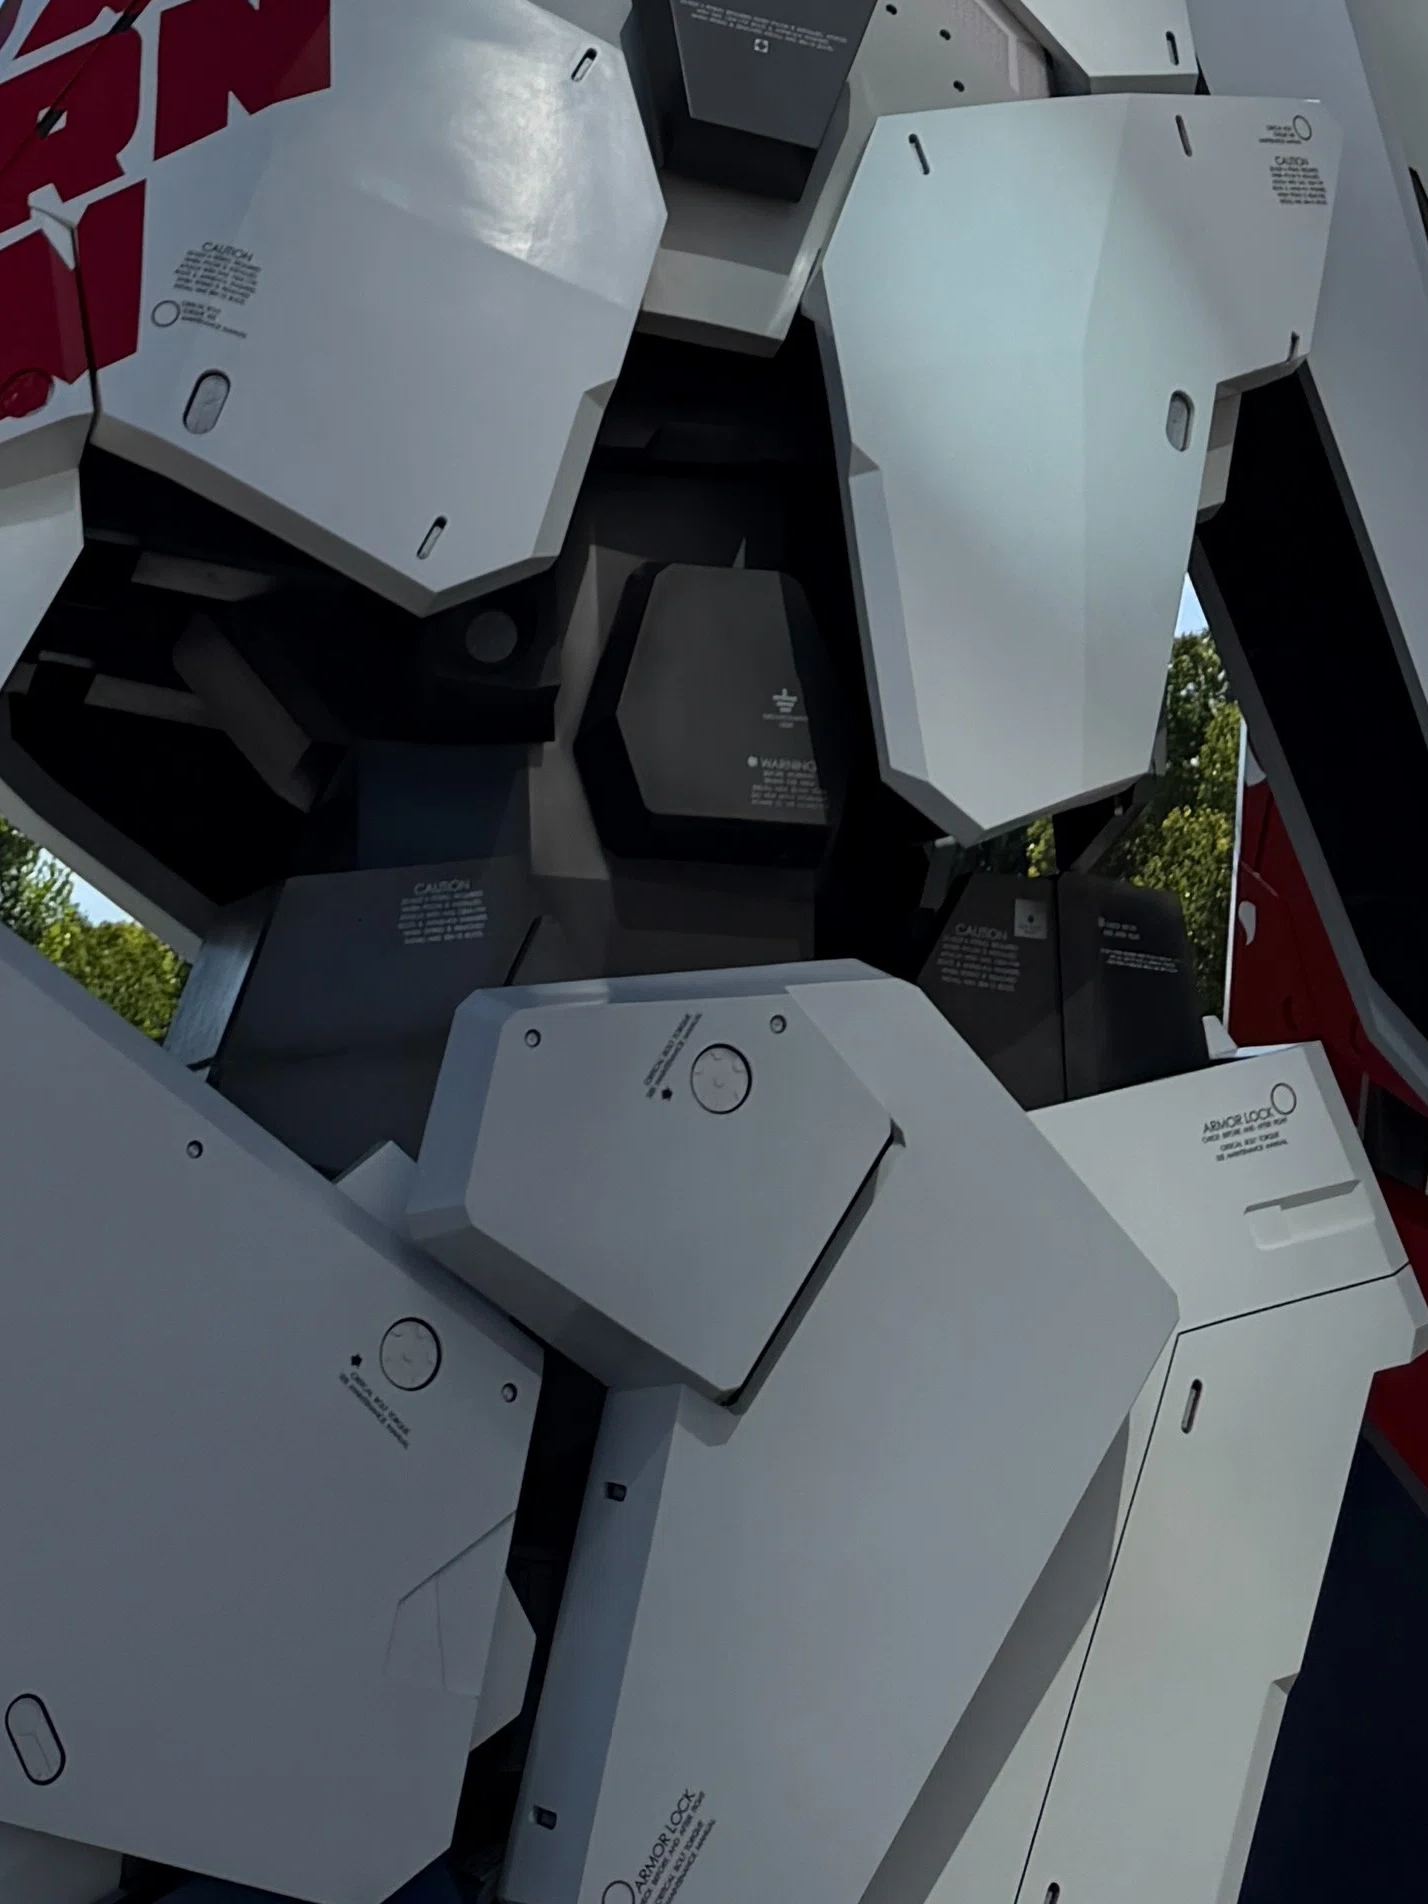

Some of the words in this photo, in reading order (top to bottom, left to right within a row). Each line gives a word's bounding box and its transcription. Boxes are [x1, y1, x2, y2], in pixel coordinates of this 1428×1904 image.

[201, 242, 254, 262] CAUTION
[955, 922, 1009, 942] CAUTION
[635, 1833, 671, 1894] ARMOR
[664, 1788, 696, 1834] LOCK
